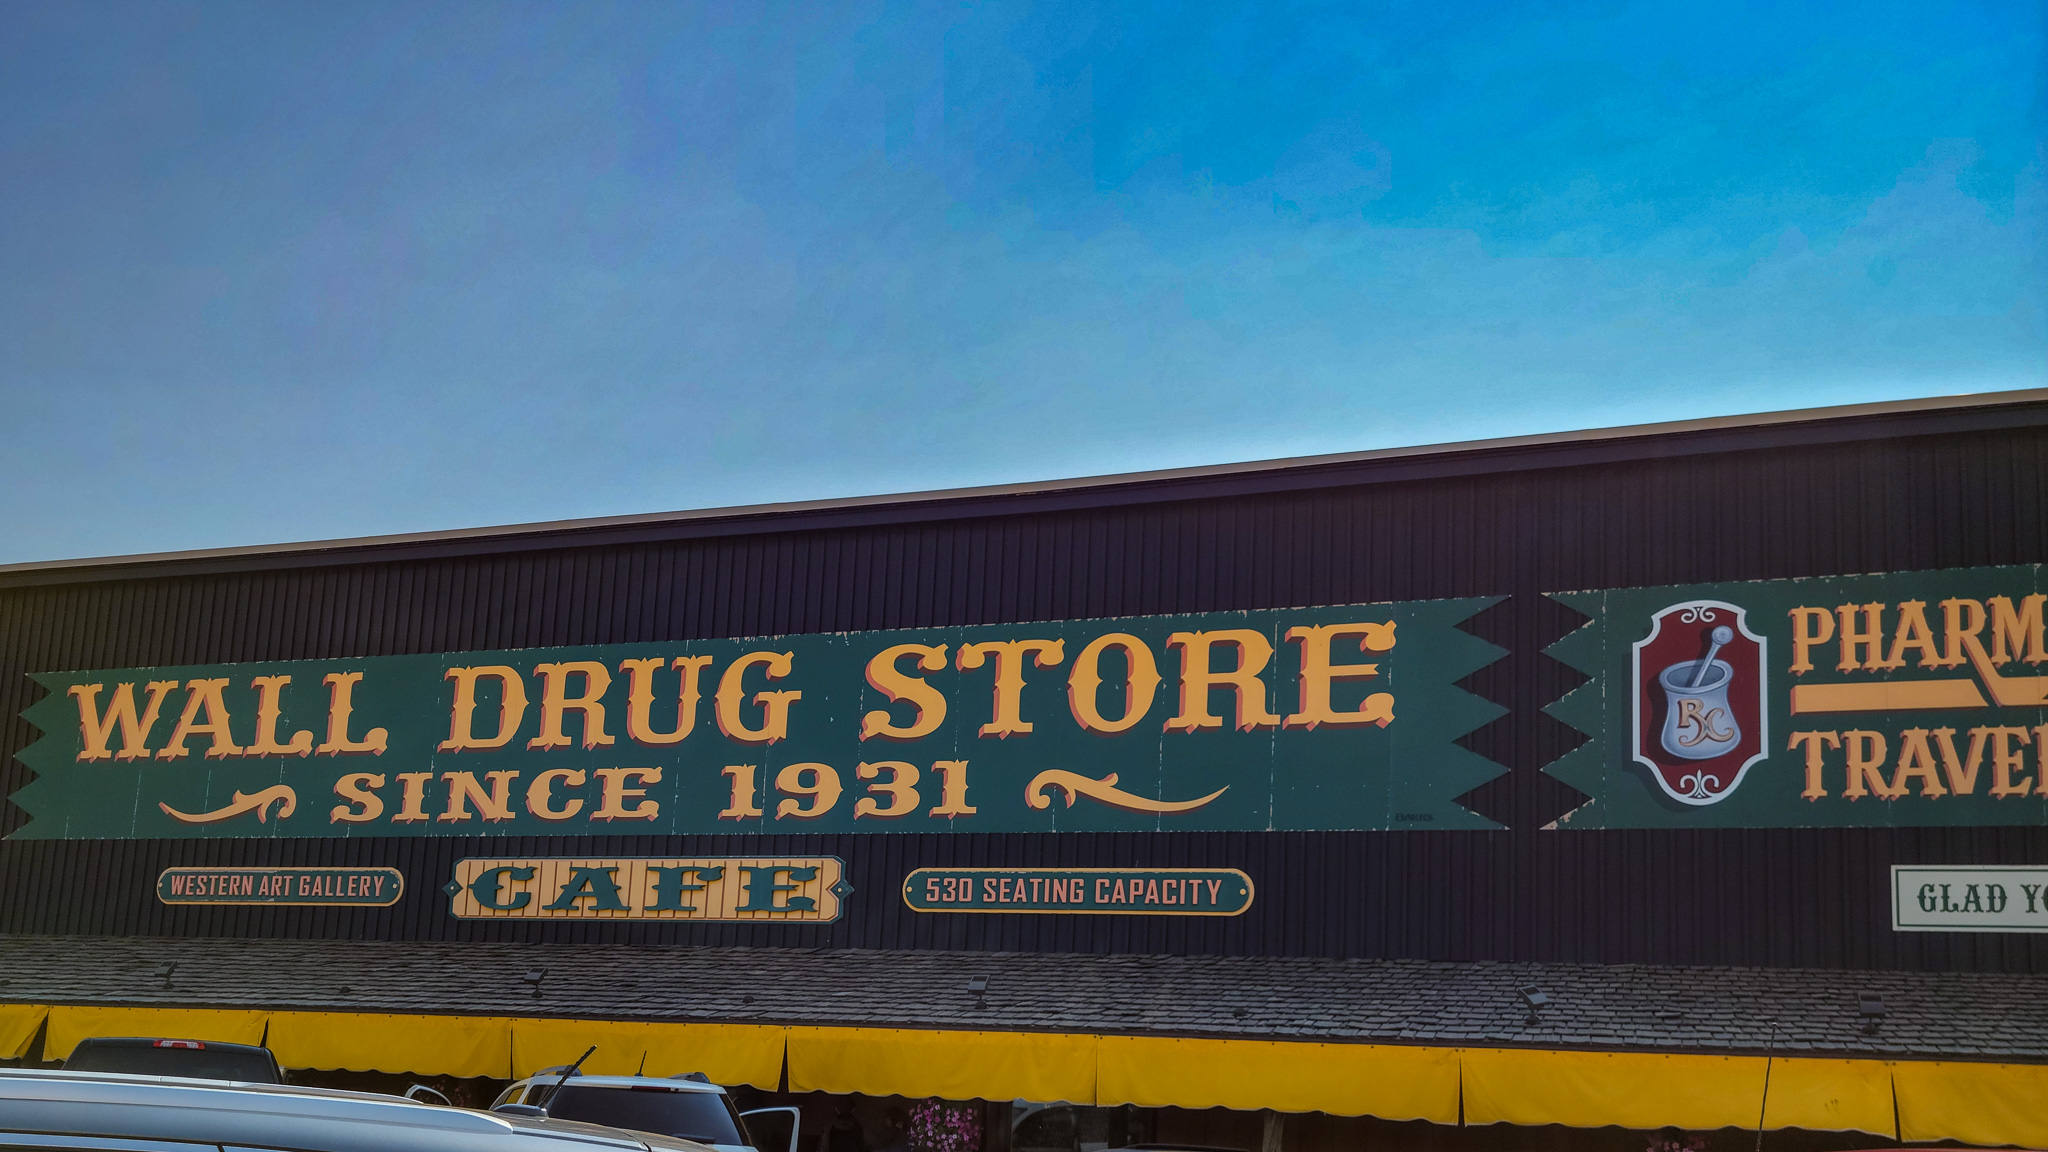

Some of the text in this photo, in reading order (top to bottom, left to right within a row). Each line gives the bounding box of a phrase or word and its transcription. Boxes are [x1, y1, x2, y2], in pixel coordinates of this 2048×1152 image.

[67, 619, 1397, 763] WALL DRUG STORE
[330, 760, 977, 825] SINCE 1931
[171, 875, 385, 897] WESTERN ART GALLERY
[467, 866, 821, 913] CAFE
[926, 877, 1223, 905] 530 SEATING CAPACITY
[1917, 883, 2008, 914] GLAD
